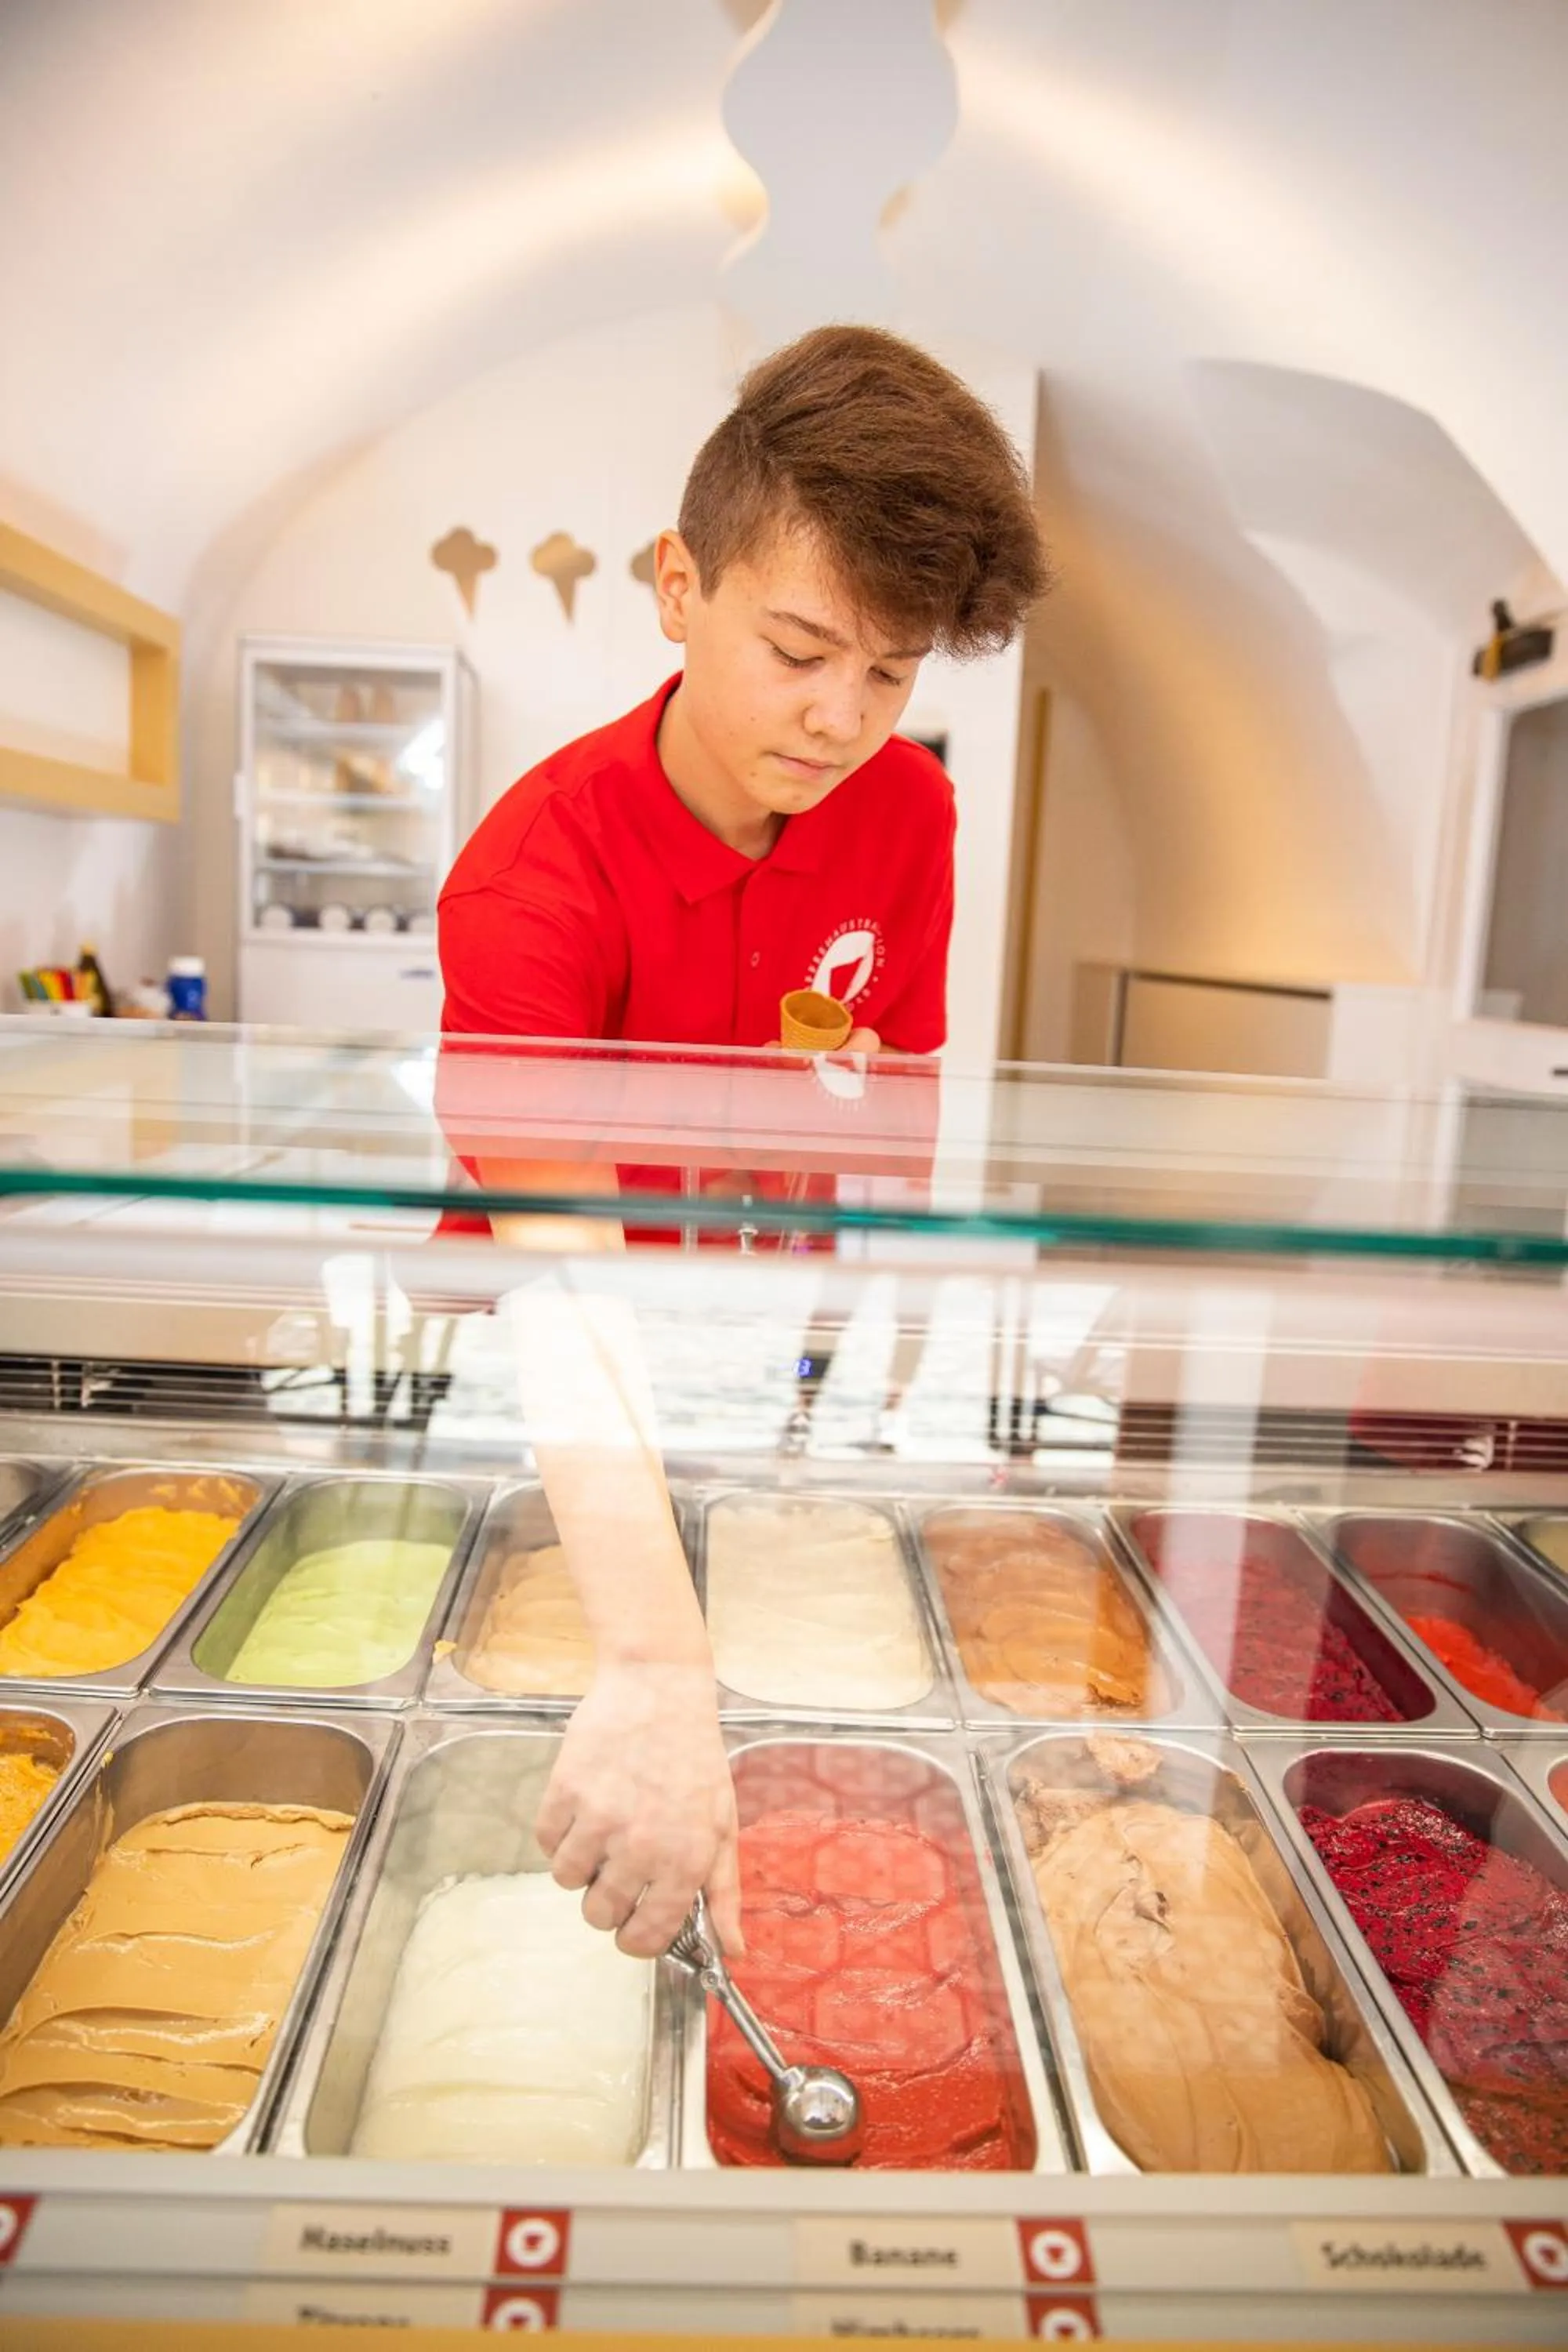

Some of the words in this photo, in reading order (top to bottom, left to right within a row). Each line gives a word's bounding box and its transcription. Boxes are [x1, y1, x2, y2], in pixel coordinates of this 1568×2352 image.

[299, 2223, 452, 2255] Haselnuss
[849, 2239, 959, 2267] Banane
[1320, 2241, 1487, 2270] Schokolade
